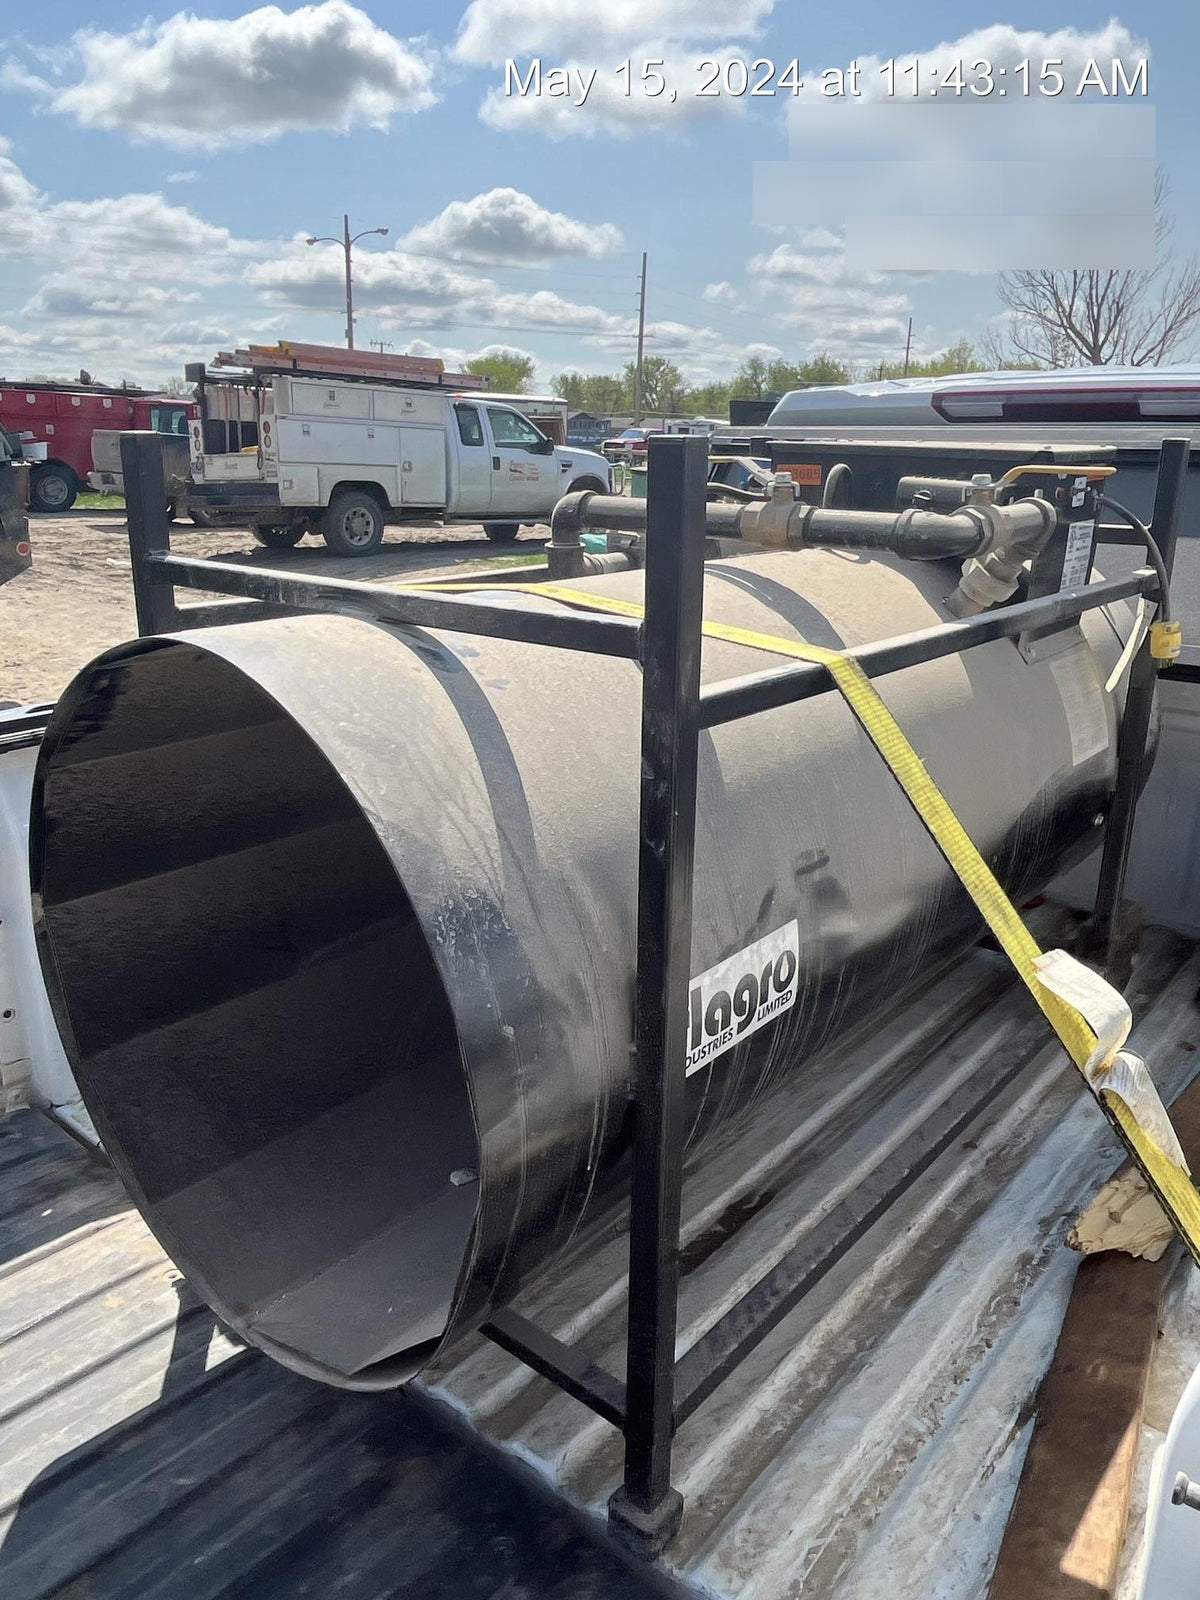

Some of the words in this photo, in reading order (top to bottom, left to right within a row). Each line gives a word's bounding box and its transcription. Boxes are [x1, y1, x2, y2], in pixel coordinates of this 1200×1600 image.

[688, 950, 797, 1051] lagro
[757, 989, 793, 1022] LIMITED
[686, 1028, 734, 1069] DUSTRIES
